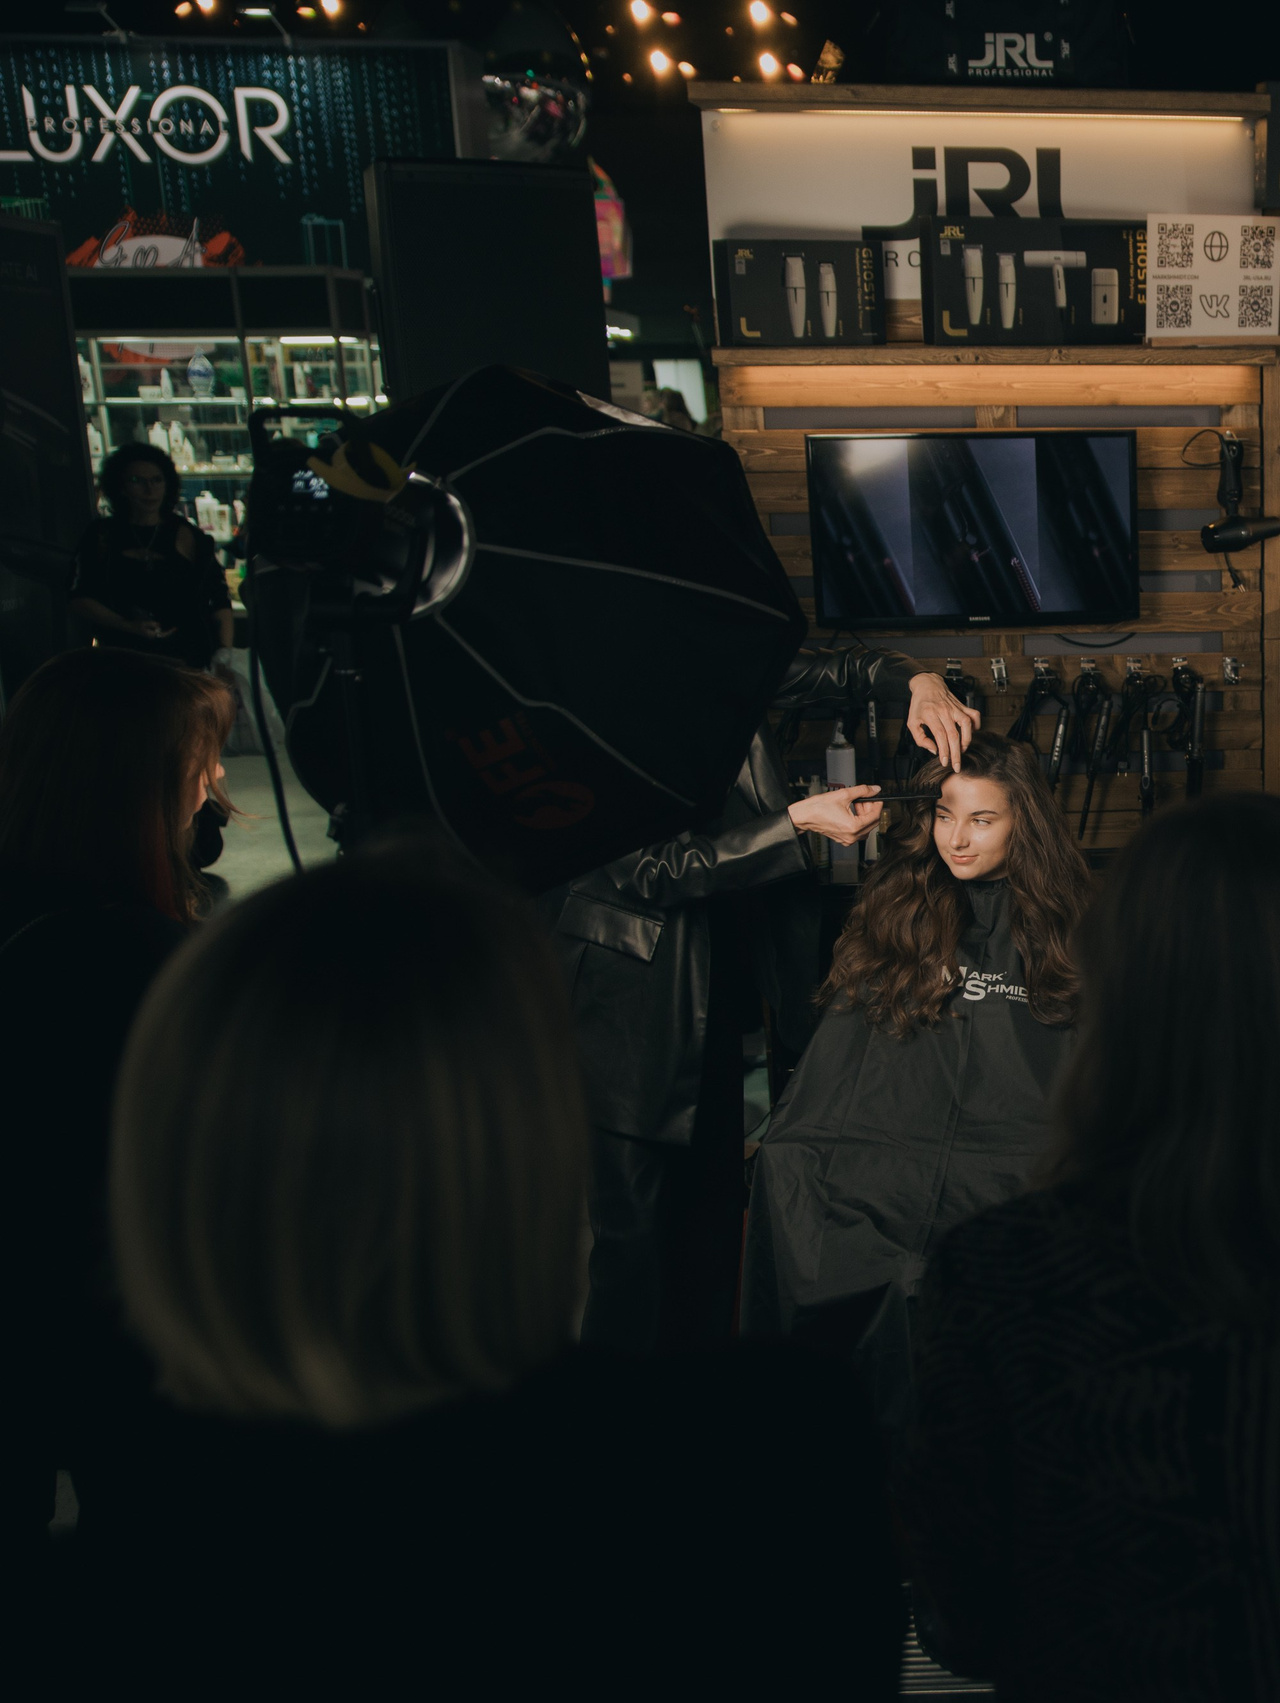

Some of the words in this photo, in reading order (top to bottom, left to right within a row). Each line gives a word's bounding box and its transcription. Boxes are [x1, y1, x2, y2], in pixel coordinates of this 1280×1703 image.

[968, 32, 1054, 68] JRL
[968, 68, 1054, 77] PROFESSIONAL
[0, 84, 294, 164] UXOR
[27, 117, 229, 136] PROFESSIONAL
[939, 225, 966, 237] JRL
[861, 247, 875, 303] GHOST
[963, 979, 1029, 1001] SHMID
